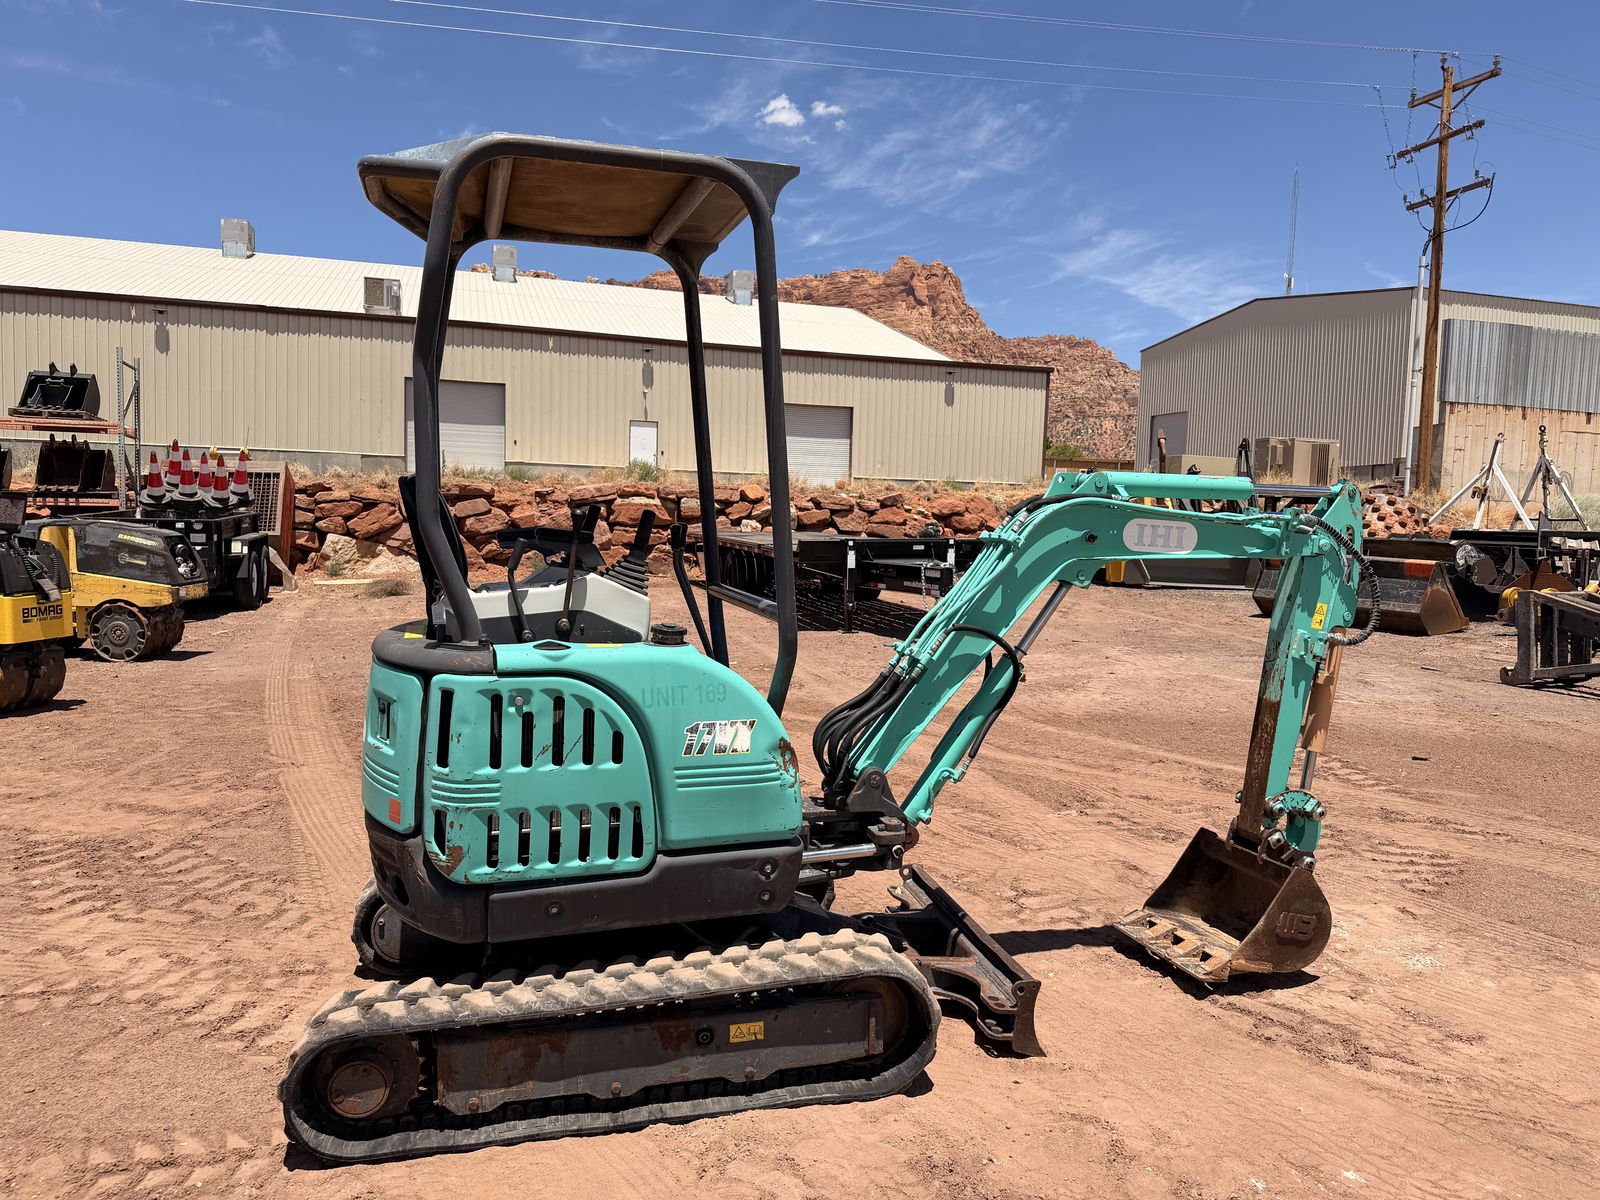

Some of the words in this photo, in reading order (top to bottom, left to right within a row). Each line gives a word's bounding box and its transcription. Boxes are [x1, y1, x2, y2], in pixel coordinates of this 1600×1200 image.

[1135, 522, 1187, 550] IHI
[22, 604, 63, 618] BOMAG
[641, 685, 687, 708] UNIT
[696, 682, 727, 704] 169
